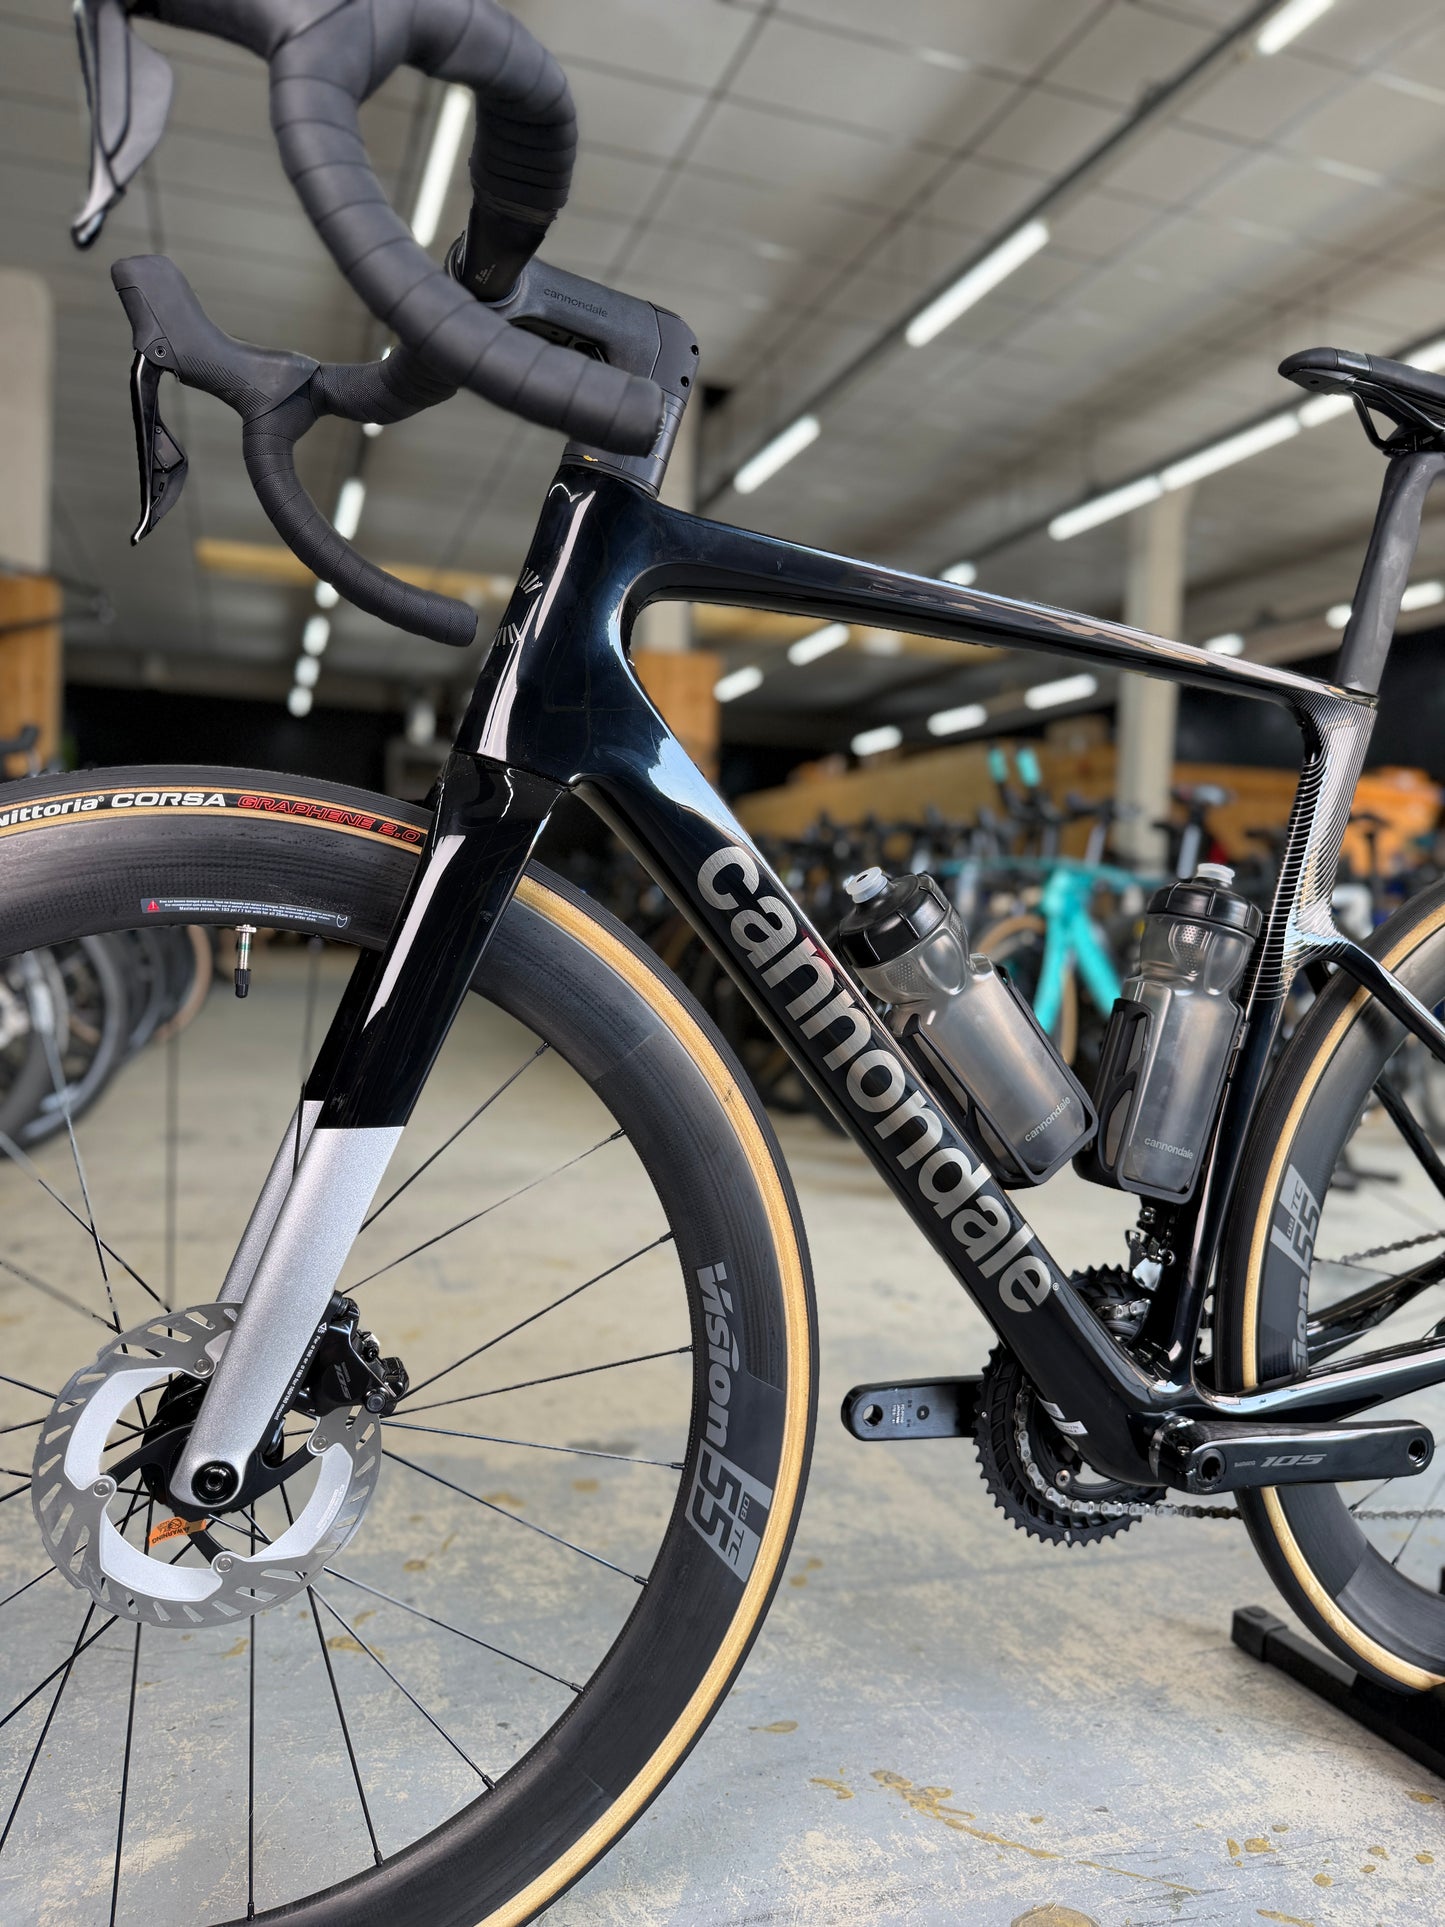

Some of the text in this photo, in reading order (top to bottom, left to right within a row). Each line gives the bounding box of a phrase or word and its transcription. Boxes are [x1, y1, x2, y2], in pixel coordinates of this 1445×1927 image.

[544, 288, 609, 318] cannondale
[111, 792, 227, 808] CORSA
[238, 795, 376, 830] GRAPHENE
[378, 822, 421, 843] 2.0
[1025, 1095, 1071, 1142] cannondale
[1144, 1136, 1194, 1160] cannondale
[1292, 1192, 1320, 1268] 55
[333, 1363, 352, 1400] 105
[1260, 1453, 1328, 1468] 105
[691, 1449, 742, 1552] 55
[728, 1529, 745, 1566] TC
